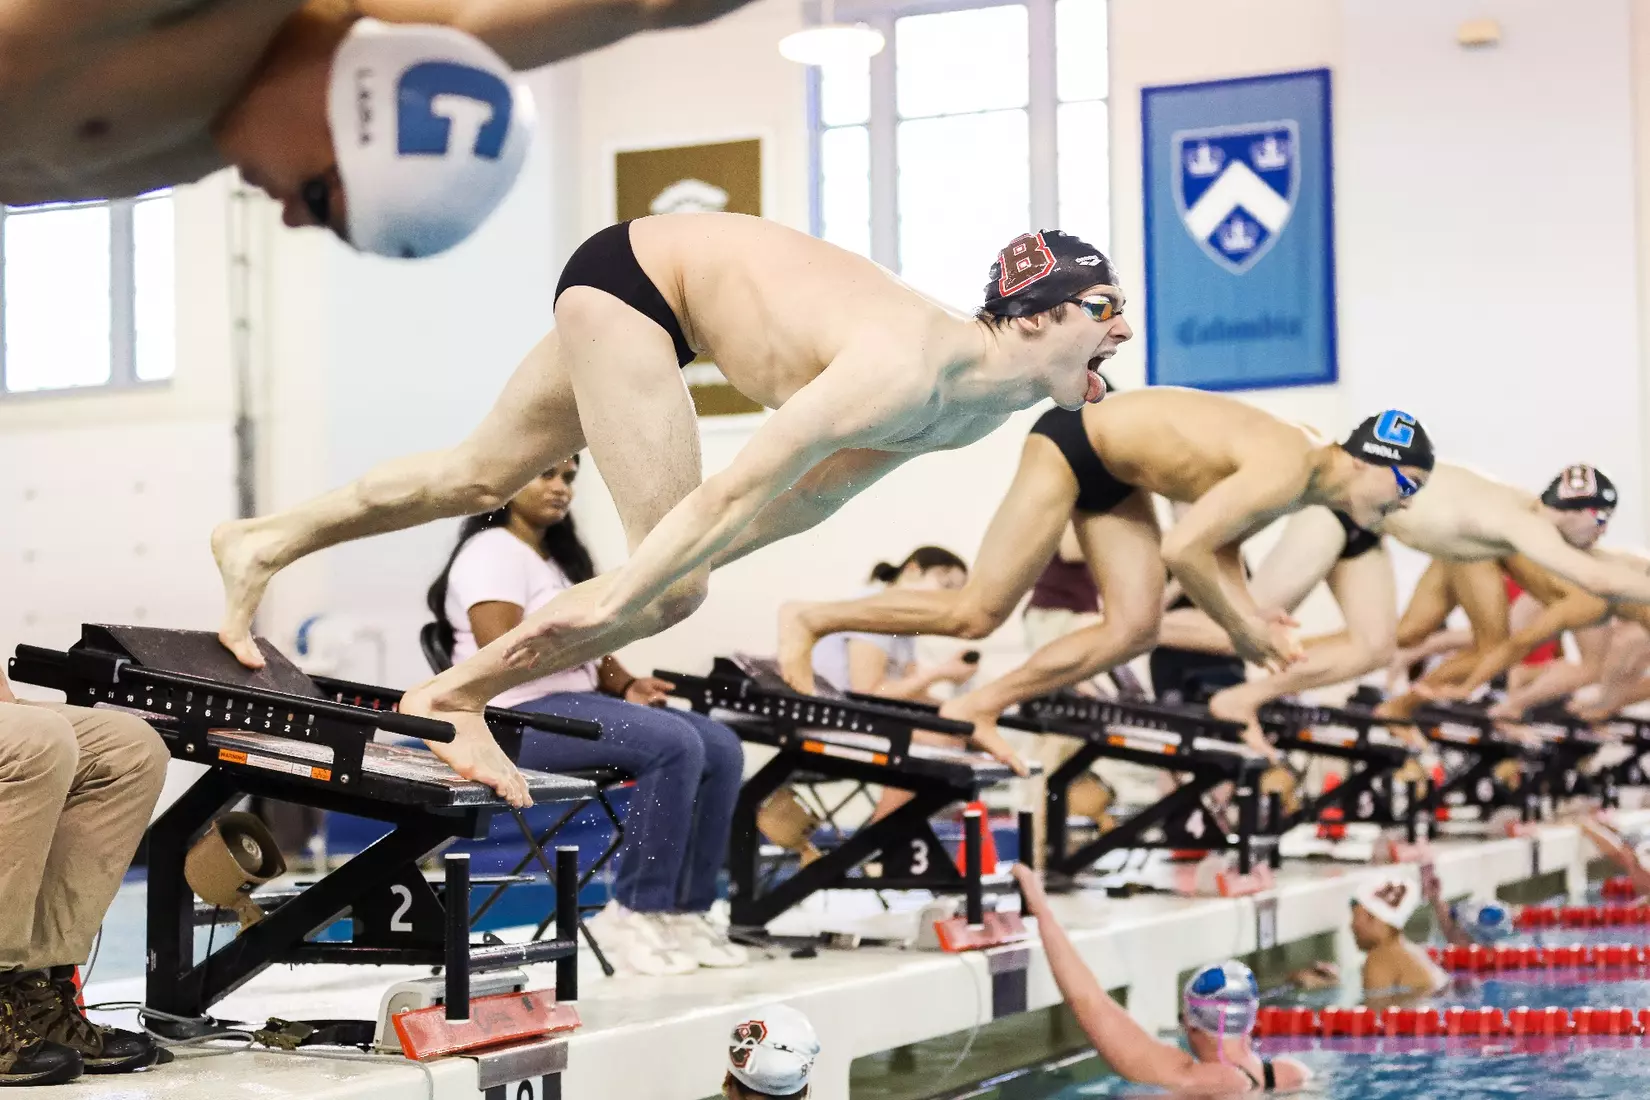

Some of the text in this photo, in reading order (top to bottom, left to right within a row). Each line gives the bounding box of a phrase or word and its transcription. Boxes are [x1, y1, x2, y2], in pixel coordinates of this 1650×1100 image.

[998, 232, 1057, 297] B
[126, 694, 134, 702] 10
[146, 698, 153, 706] 9
[165, 702, 172, 710] 8
[185, 705, 192, 713] 7
[204, 709, 212, 717] 6
[224, 713, 231, 721] 5
[244, 717, 251, 725] 4
[264, 720, 271, 728] 3
[284, 724, 291, 733] 2
[304, 728, 311, 736] 1
[910, 839, 929, 875] 3
[389, 884, 414, 933] 2
